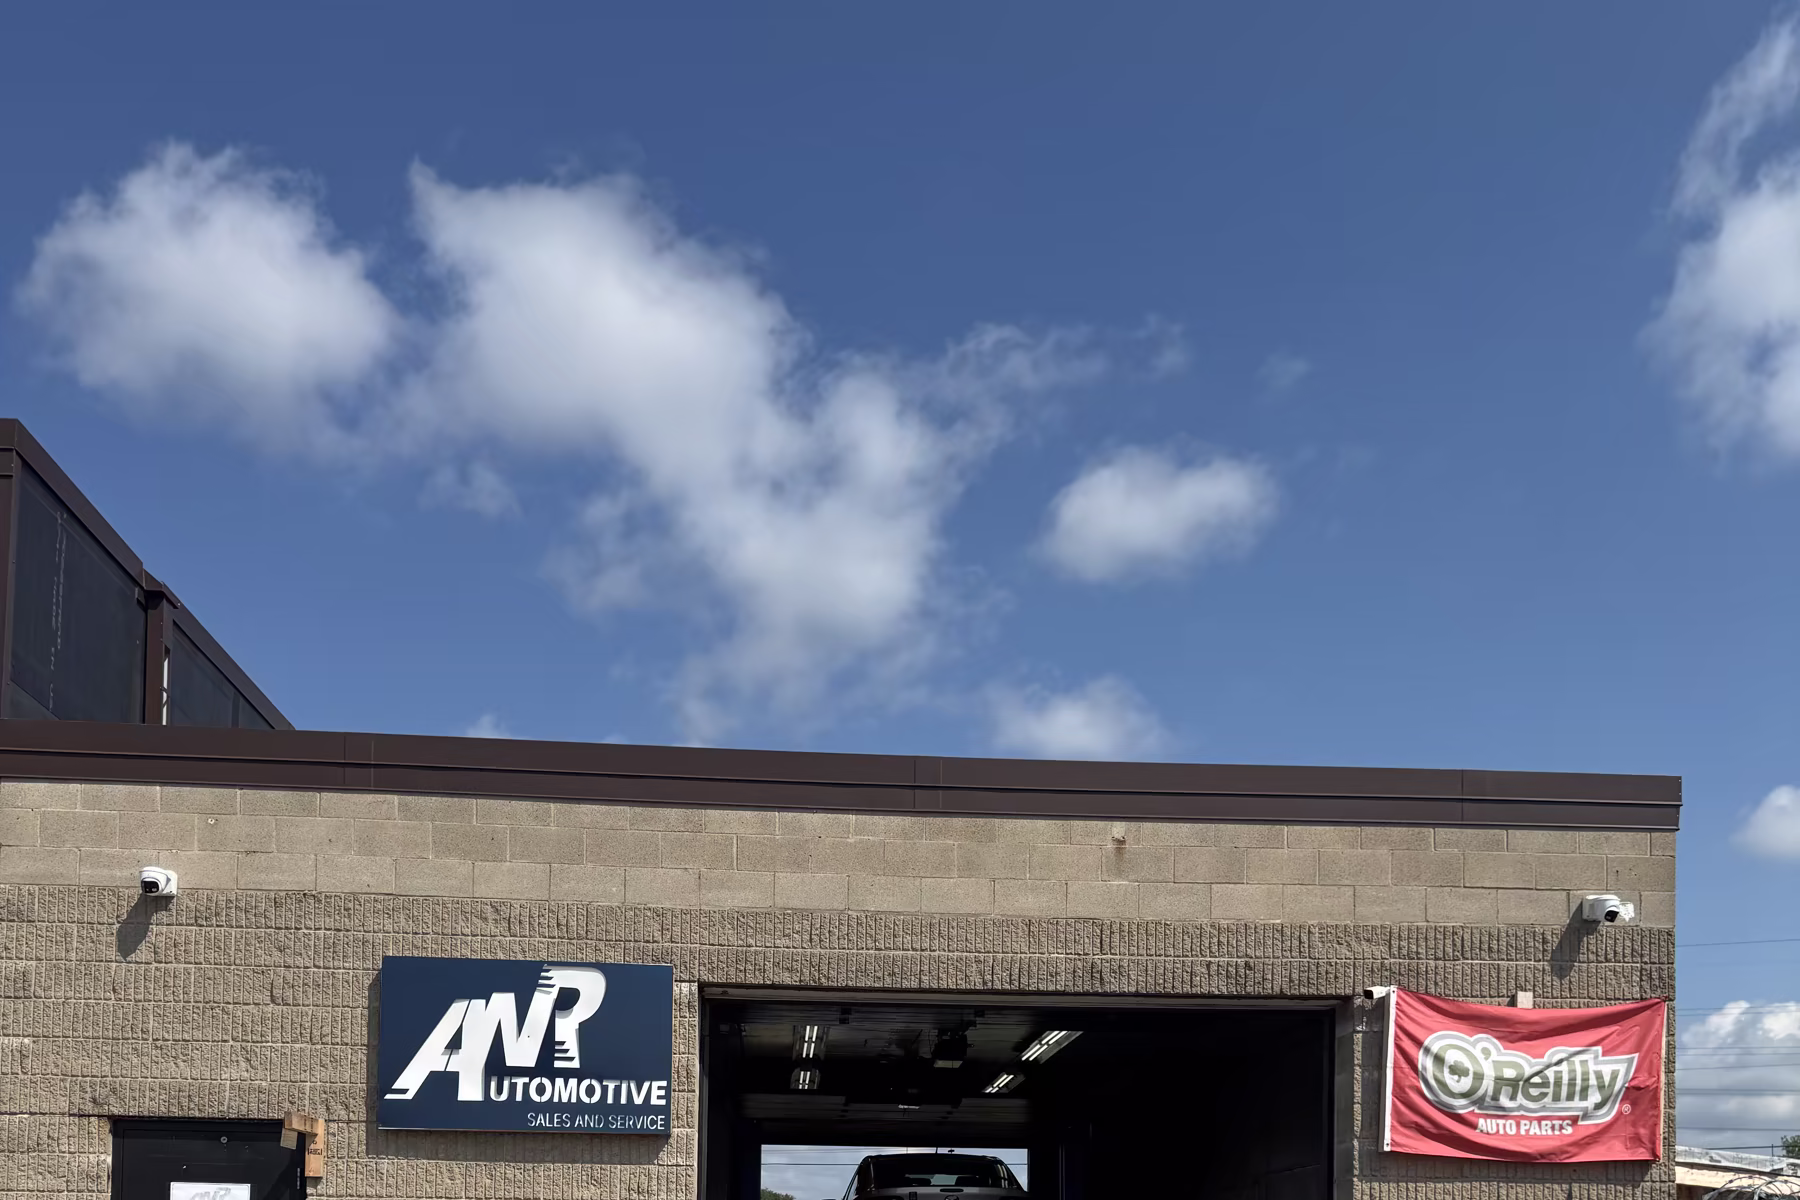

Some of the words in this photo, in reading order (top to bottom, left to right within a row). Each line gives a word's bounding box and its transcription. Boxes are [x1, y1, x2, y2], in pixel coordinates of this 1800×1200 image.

[1425, 1038, 1629, 1116] O'Reilly
[527, 1112, 571, 1127] SALES
[574, 1114, 604, 1129] AND
[608, 1115, 666, 1130] SERVICE
[1476, 1117, 1517, 1135] AUTO
[1519, 1119, 1573, 1136] PARTS
